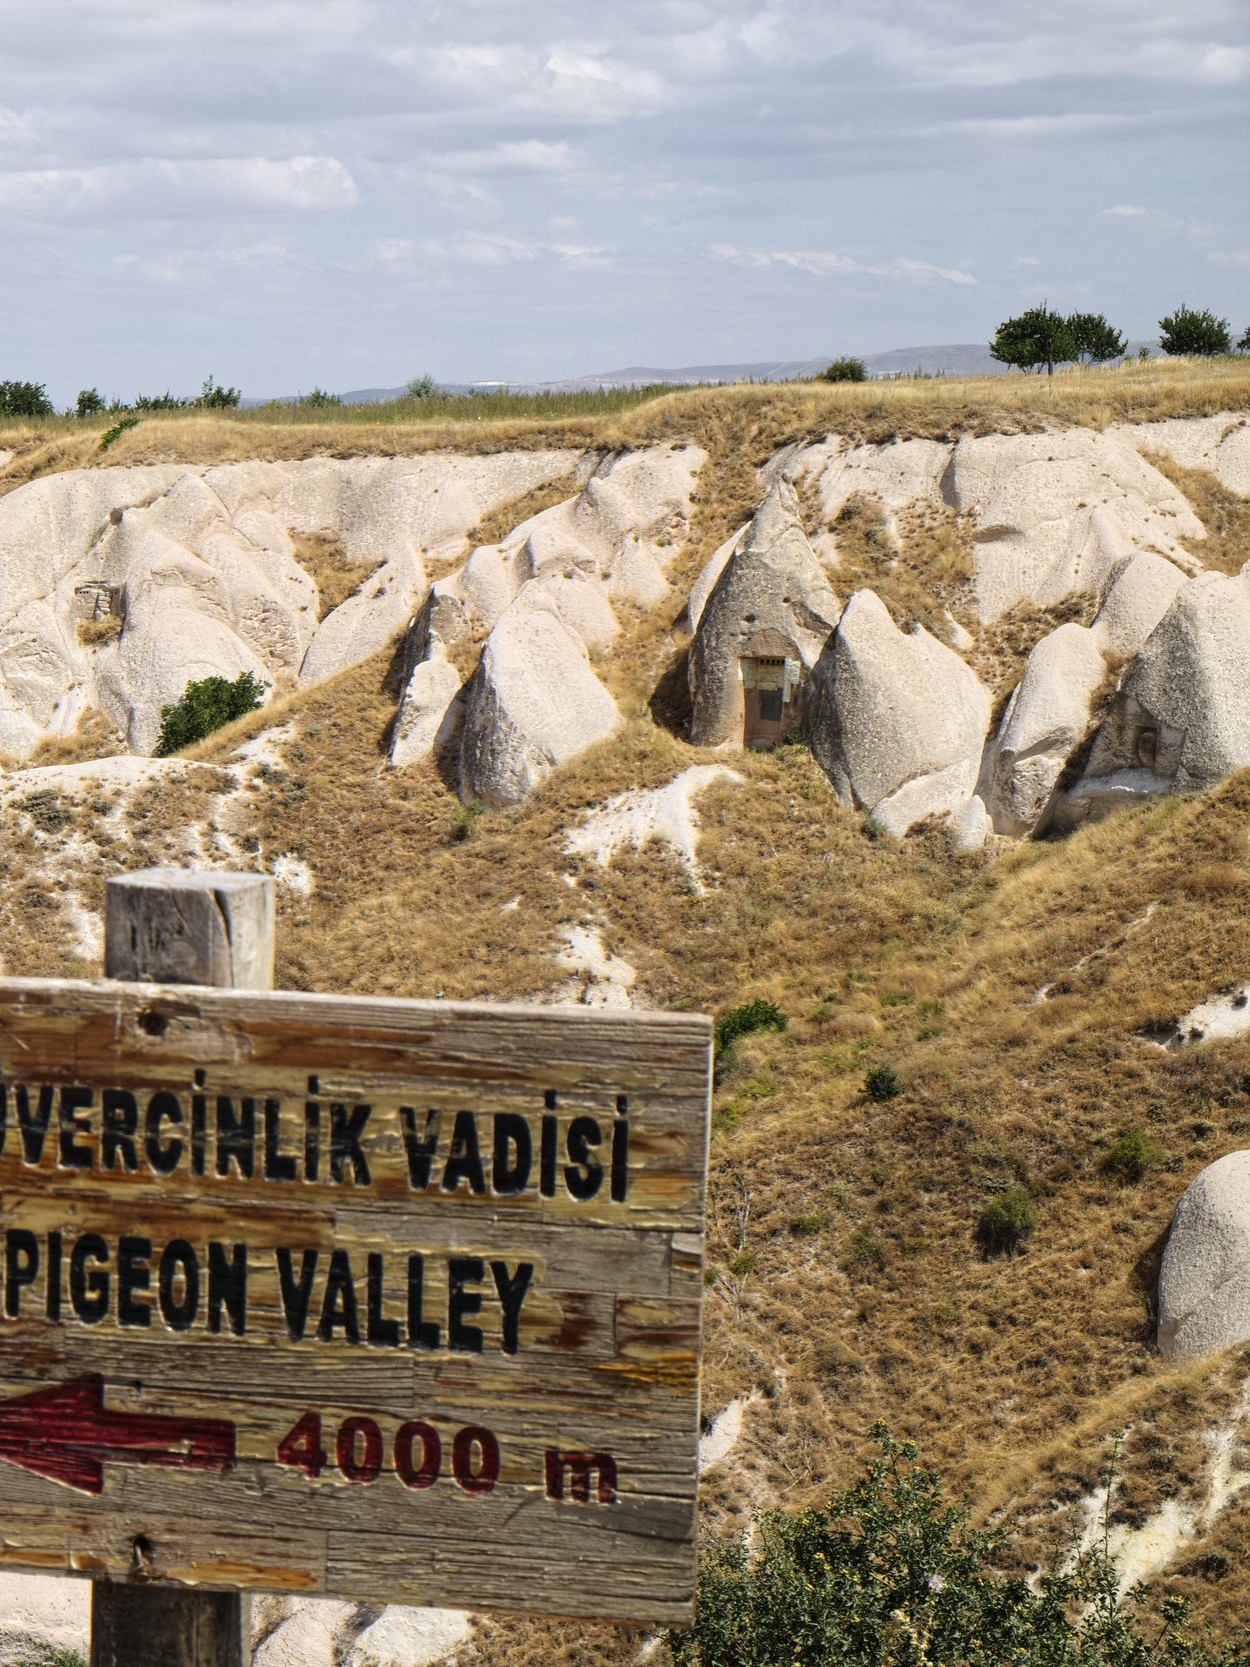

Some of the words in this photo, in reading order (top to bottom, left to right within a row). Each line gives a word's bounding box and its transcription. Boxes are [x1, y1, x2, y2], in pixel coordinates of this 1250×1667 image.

[400, 1090, 629, 1202] VADİSİ
[5, 1230, 248, 1336] PIGEON
[276, 1249, 534, 1355] VALLEY
[277, 1412, 499, 1494] 4000
[545, 1450, 618, 1504] m
